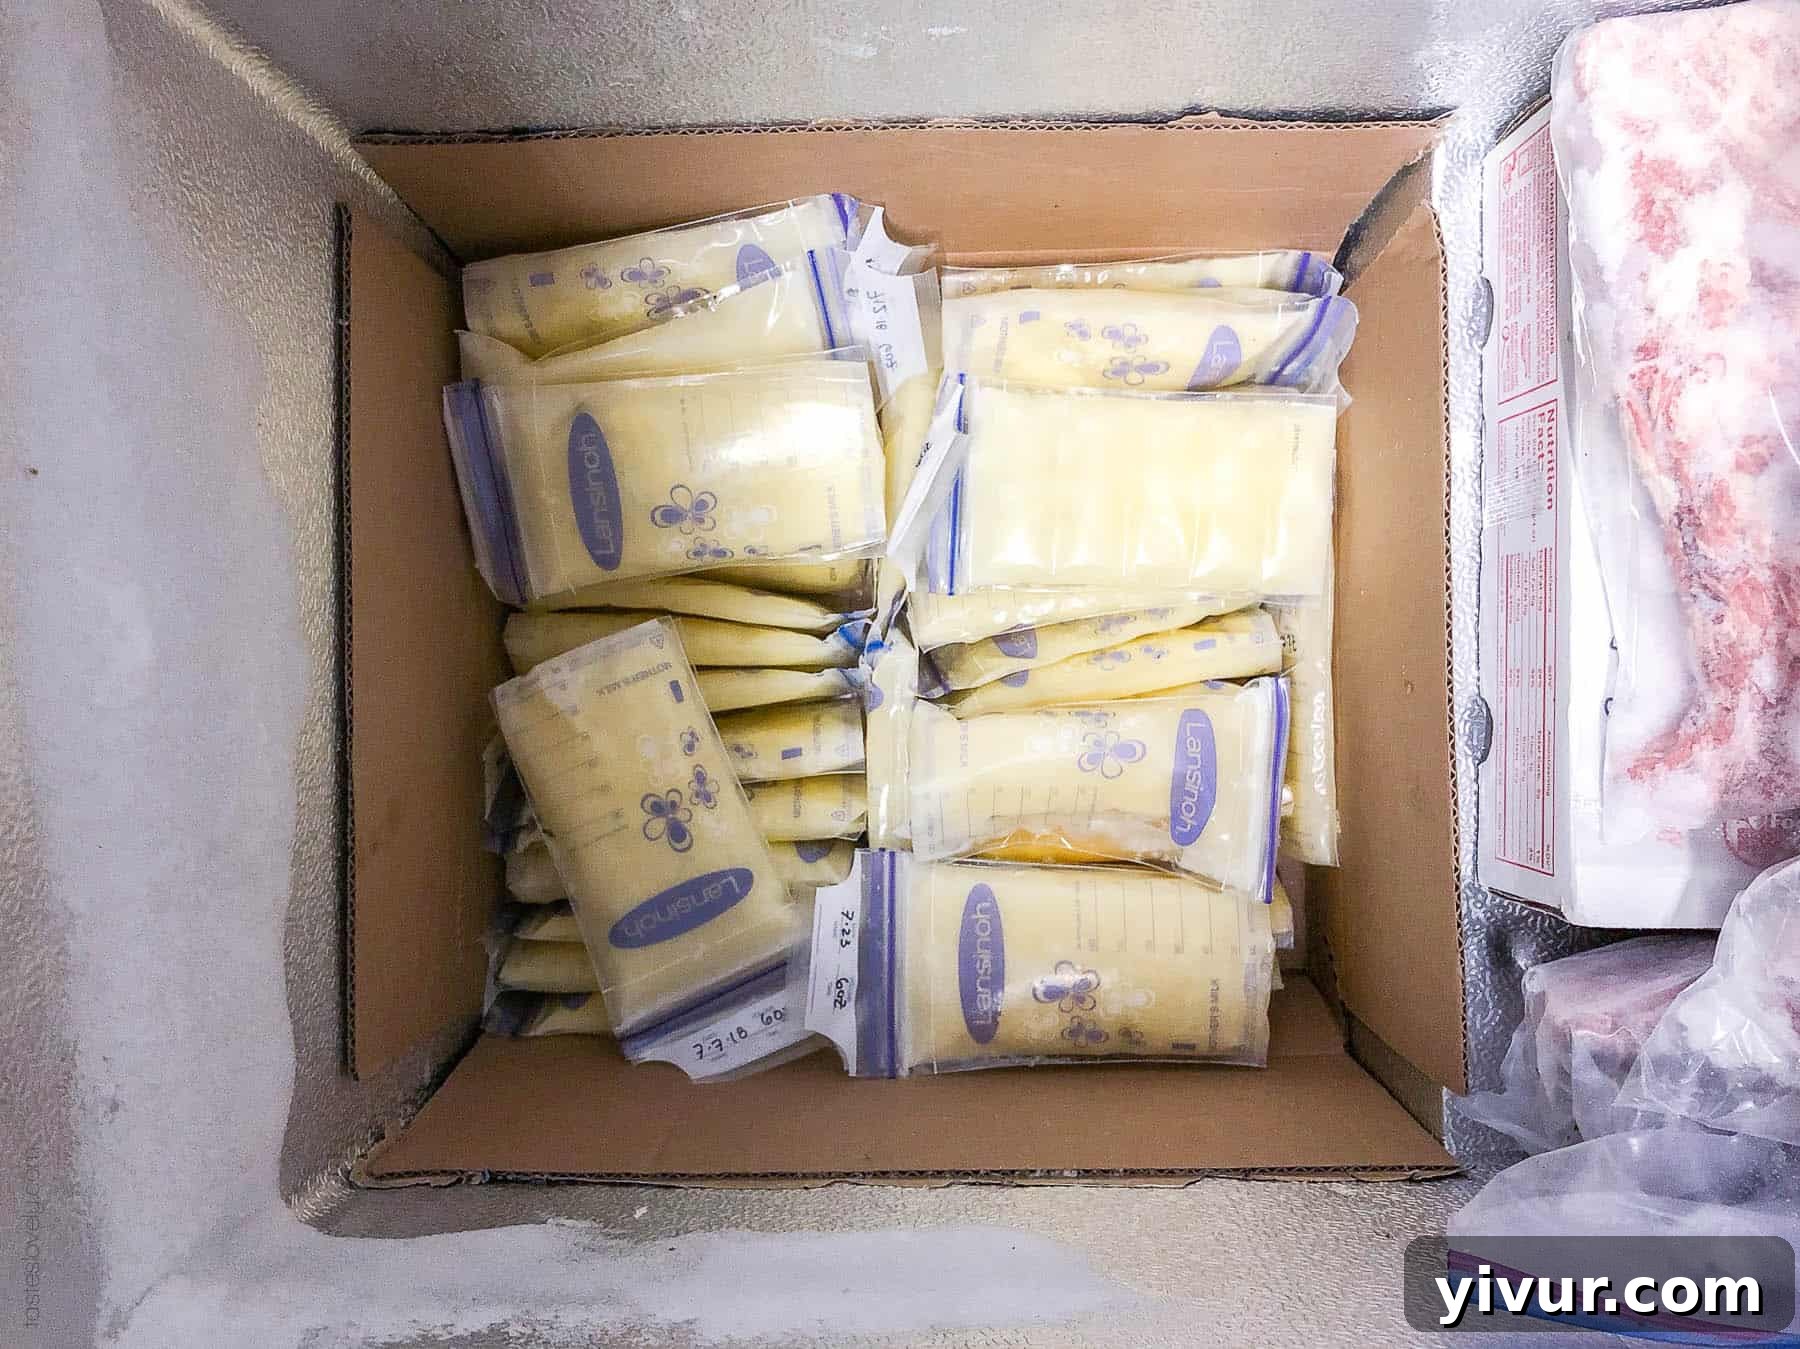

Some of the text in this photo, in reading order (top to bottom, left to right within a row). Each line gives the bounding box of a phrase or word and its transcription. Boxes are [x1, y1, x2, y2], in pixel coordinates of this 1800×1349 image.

[579, 431, 615, 556] Lansinoh
[1545, 407, 1556, 511] Nutrition
[1174, 720, 1208, 834] Lansinoh
[623, 874, 741, 941] Lansinoh
[971, 900, 993, 1026] Lansinoh
